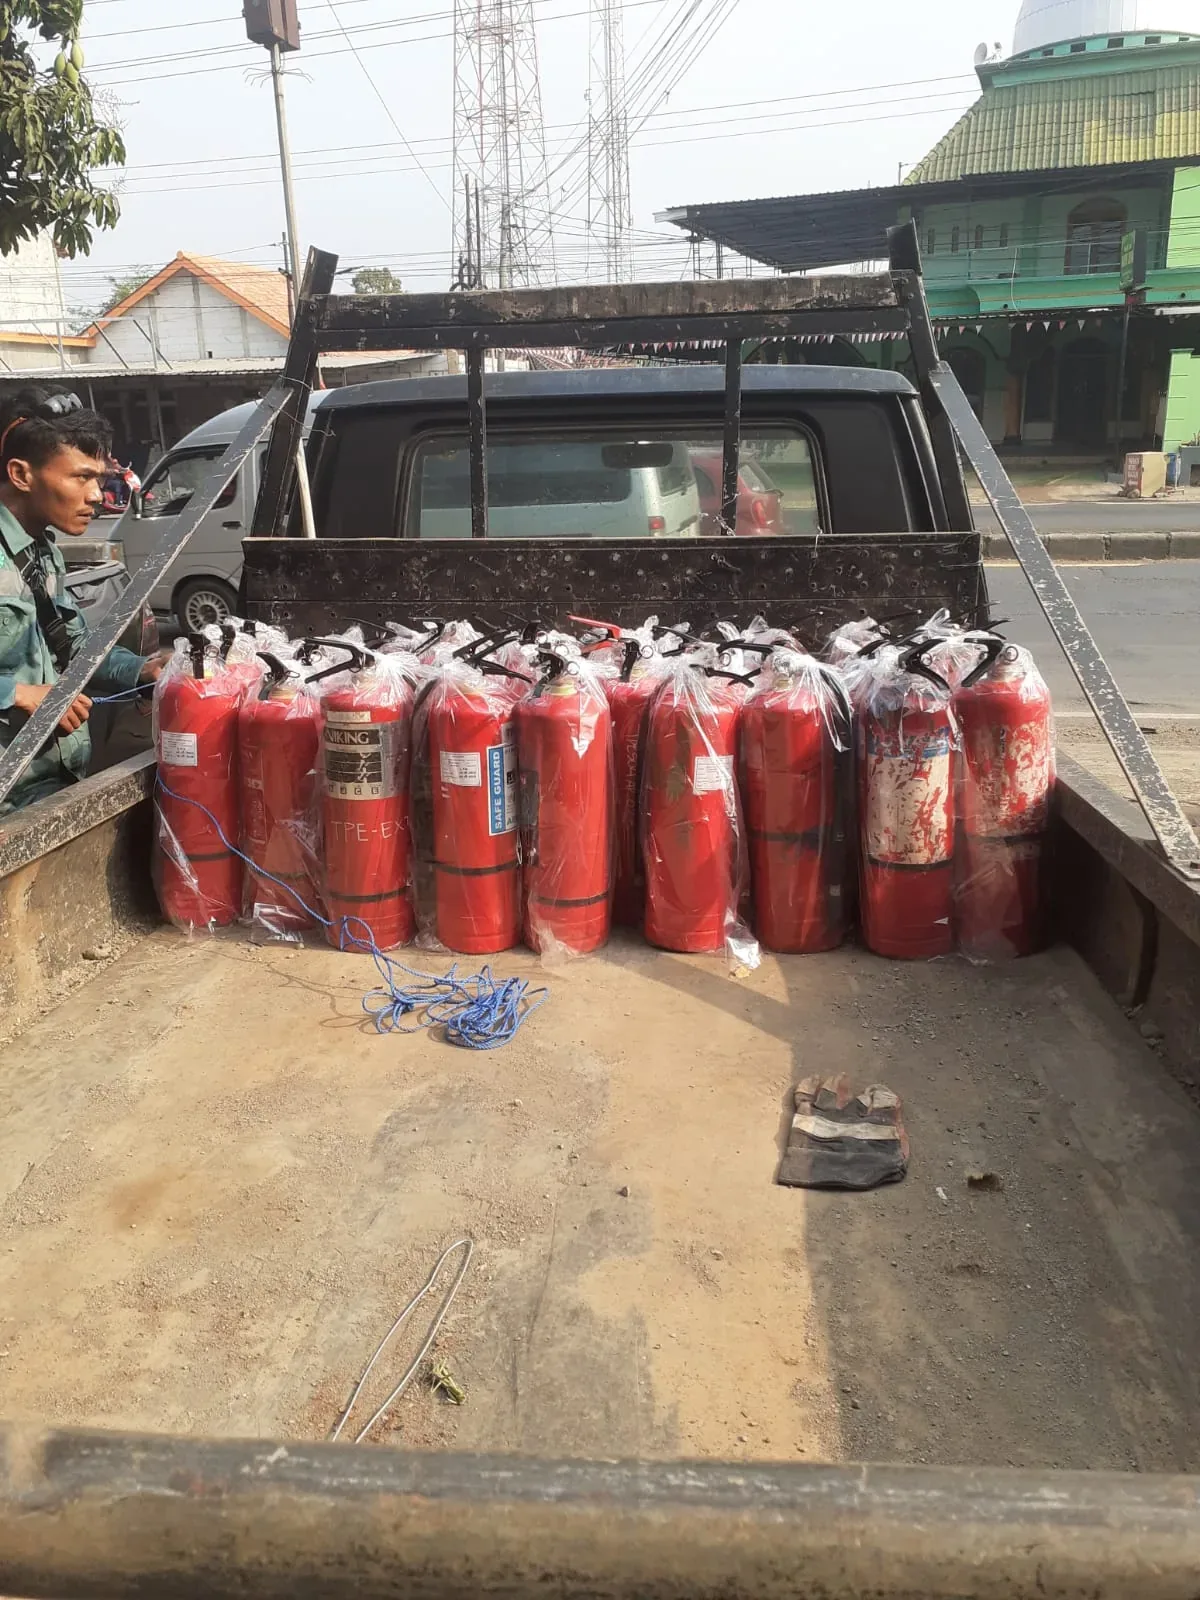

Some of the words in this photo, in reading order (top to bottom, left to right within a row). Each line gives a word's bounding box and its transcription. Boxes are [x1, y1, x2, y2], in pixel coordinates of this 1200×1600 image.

[326, 729, 369, 745] VIKING
[492, 751, 503, 795] GUARD
[494, 797, 503, 830] SAFE
